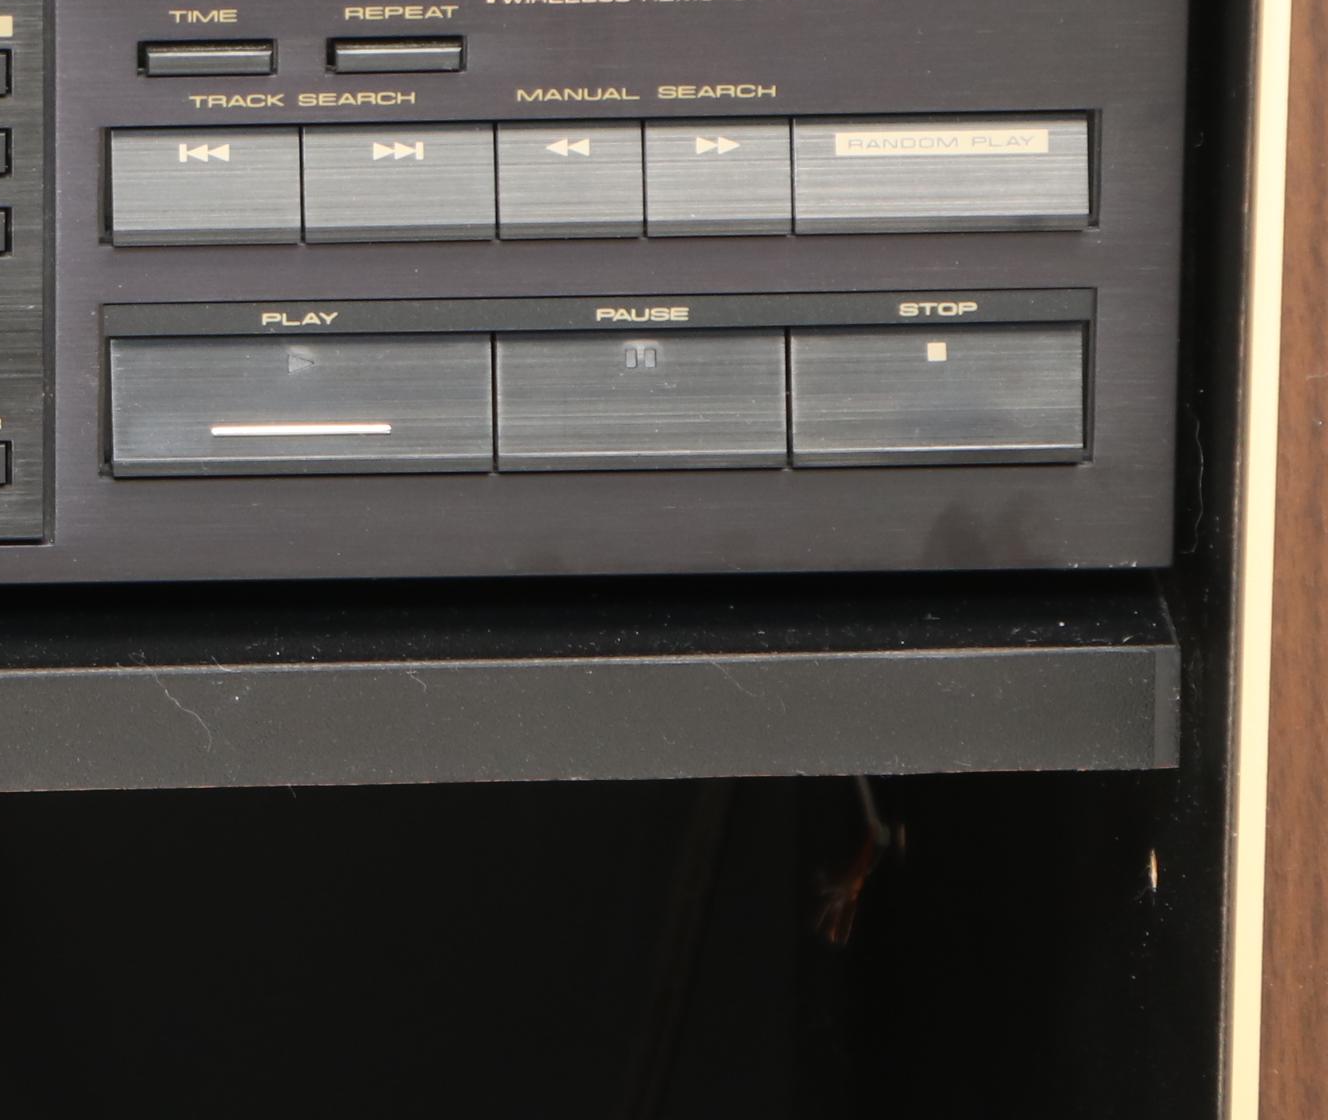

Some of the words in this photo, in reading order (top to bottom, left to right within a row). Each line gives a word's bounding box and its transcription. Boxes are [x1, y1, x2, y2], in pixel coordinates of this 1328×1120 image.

[169, 9, 237, 23] TIME
[345, 5, 458, 20] REPEAT
[189, 94, 284, 108] TRACK
[298, 92, 416, 106] SEARCH
[517, 88, 640, 101] MANUAL
[657, 84, 777, 99] SEARCH
[846, 135, 960, 153] RANDOM
[969, 134, 1035, 151] PLAY
[596, 307, 689, 321] PAUSE
[899, 301, 977, 316] STOP
[261, 312, 338, 326] PLAY
